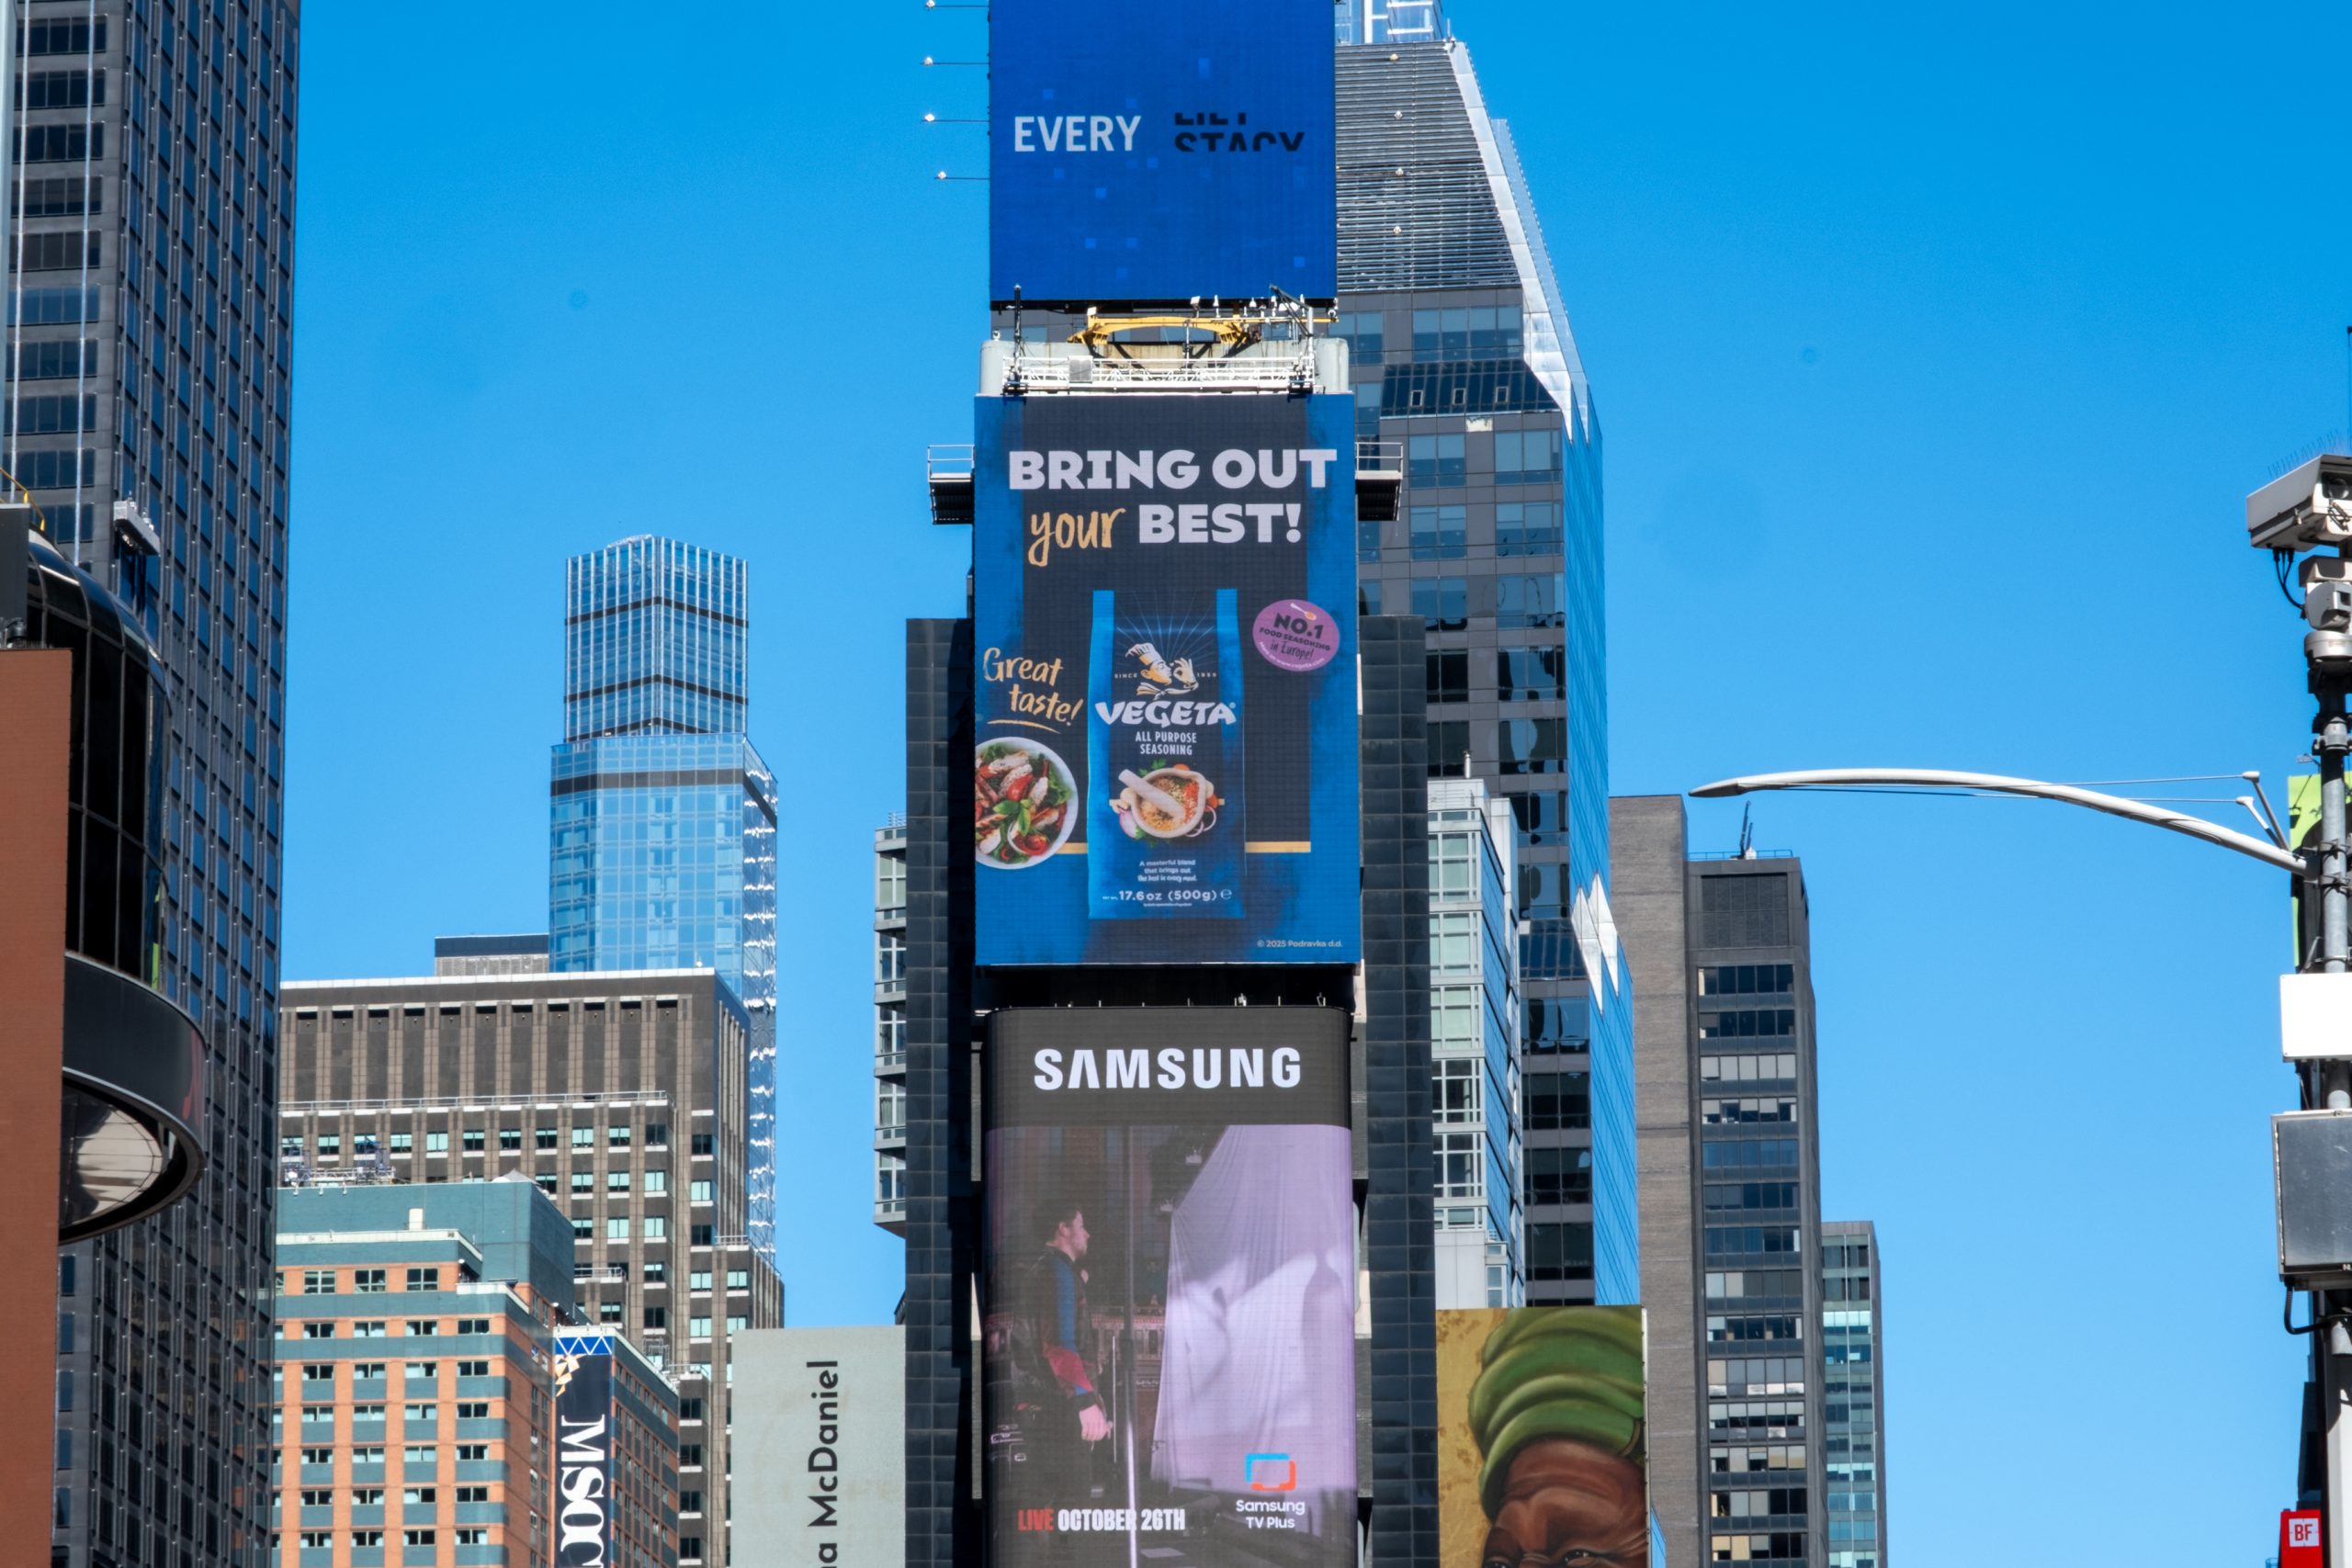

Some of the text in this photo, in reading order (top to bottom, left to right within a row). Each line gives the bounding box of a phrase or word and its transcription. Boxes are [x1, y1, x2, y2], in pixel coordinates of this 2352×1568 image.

[1014, 116, 1142, 152] EVERY
[1009, 448, 1338, 491] BRING OUT
[1028, 503, 1302, 568] your BEST!
[1273, 613, 1324, 639] NO.1
[1260, 627, 1283, 638] FOOD
[1283, 634, 1331, 651] SEASONING
[1281, 640, 1315, 660] Europe!
[983, 647, 1064, 687] Great
[1009, 683, 1084, 727] taste!
[1094, 700, 1238, 728] VEGETA
[1136, 731, 1197, 743] ALL PURPOSE
[1140, 744, 1193, 756] SEASONING
[1168, 889, 1217, 901] (500g)
[1266, 940, 1286, 948] 2025
[1288, 939, 1326, 948] Podravka
[1034, 1047, 1301, 1091] SAMSUNG
[806, 1359, 839, 1528] McDaniel
[1236, 1499, 1306, 1516] Samsung
[1017, 1508, 1185, 1532] LIVE OCTOBER 26TH
[1246, 1516, 1295, 1529] TV Plus
[2294, 1524, 2313, 1541] BF
